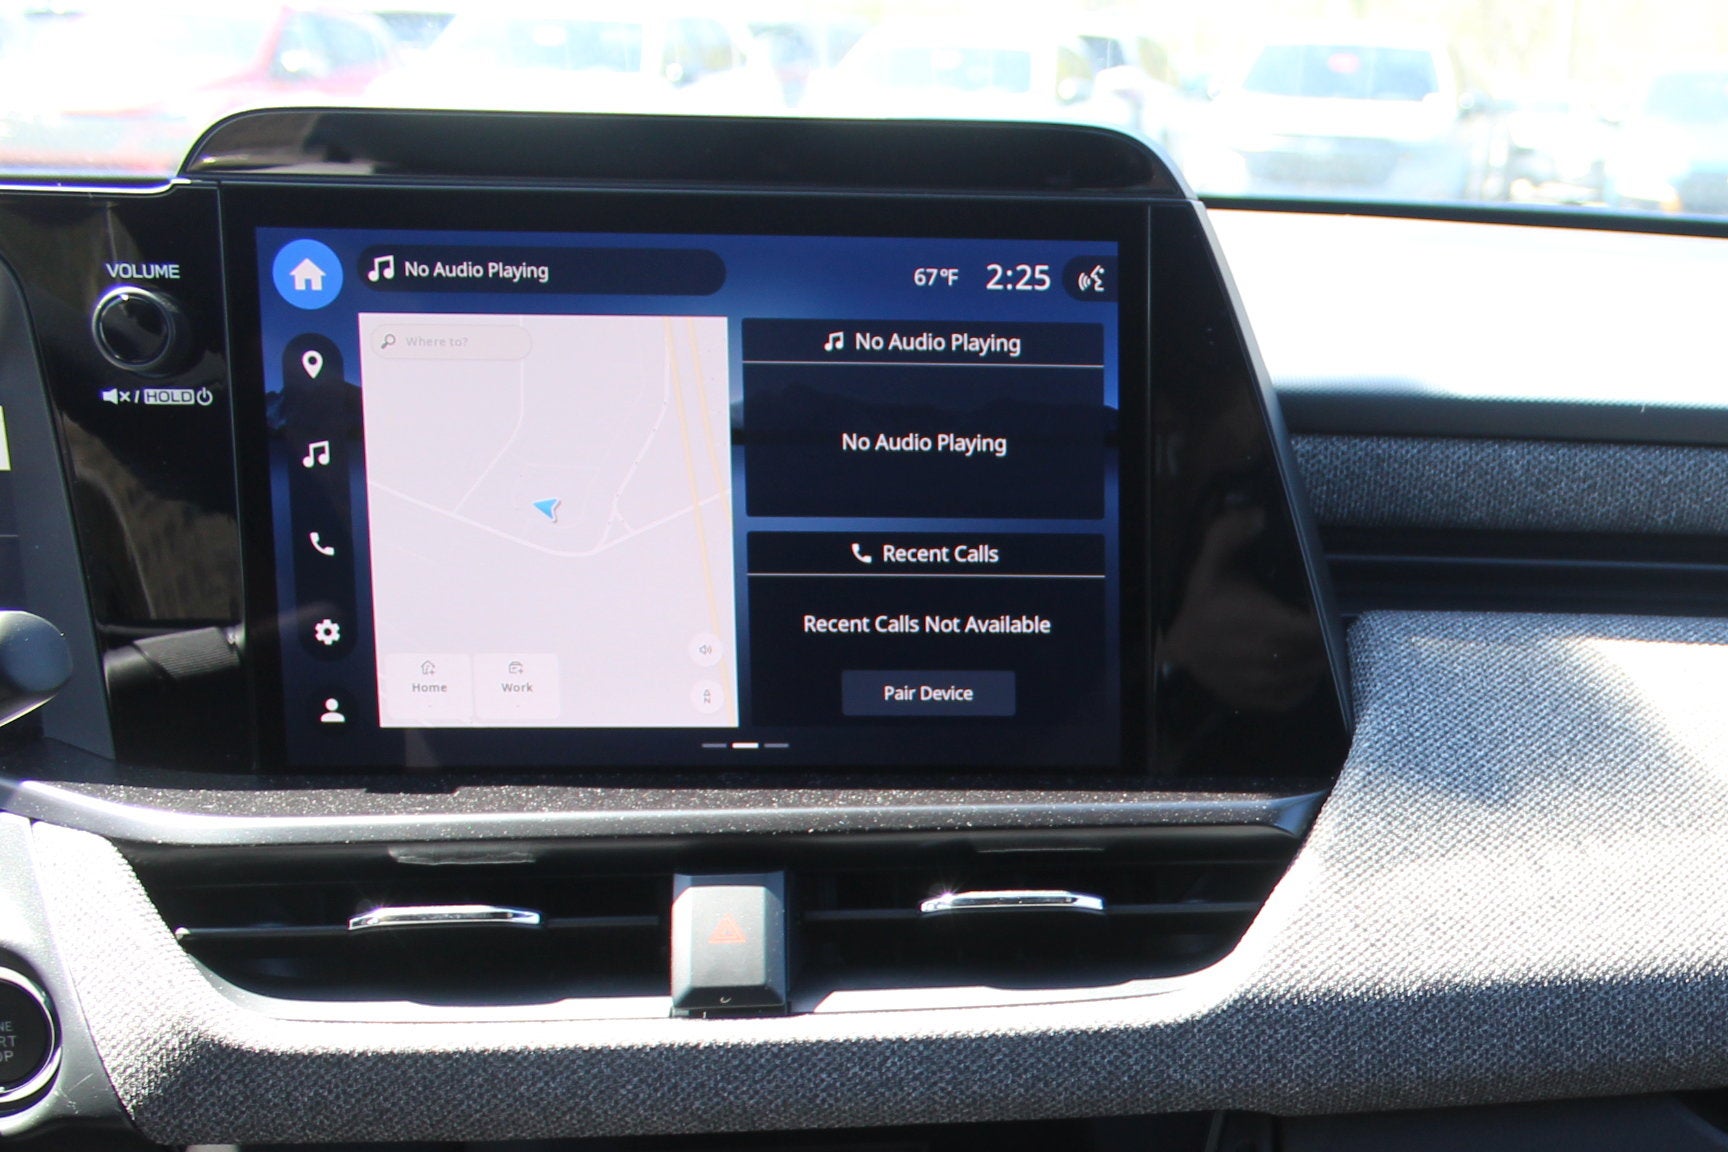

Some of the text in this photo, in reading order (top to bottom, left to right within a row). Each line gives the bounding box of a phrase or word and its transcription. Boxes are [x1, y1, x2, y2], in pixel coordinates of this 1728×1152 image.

[106, 263, 180, 279] VOLUME
[404, 261, 549, 283] No Audio Playing
[985, 264, 1051, 291] 2:25
[405, 336, 469, 347] Where to?
[855, 333, 1022, 356] No Audio Playing
[147, 391, 192, 403] HOLD
[842, 433, 1007, 456] No Audio Playing
[883, 545, 999, 563] Recent Calls
[804, 615, 1051, 634] Recent Calls Not Available
[412, 682, 448, 693] Home
[501, 682, 533, 693] Work
[884, 685, 973, 701] Pair Device
